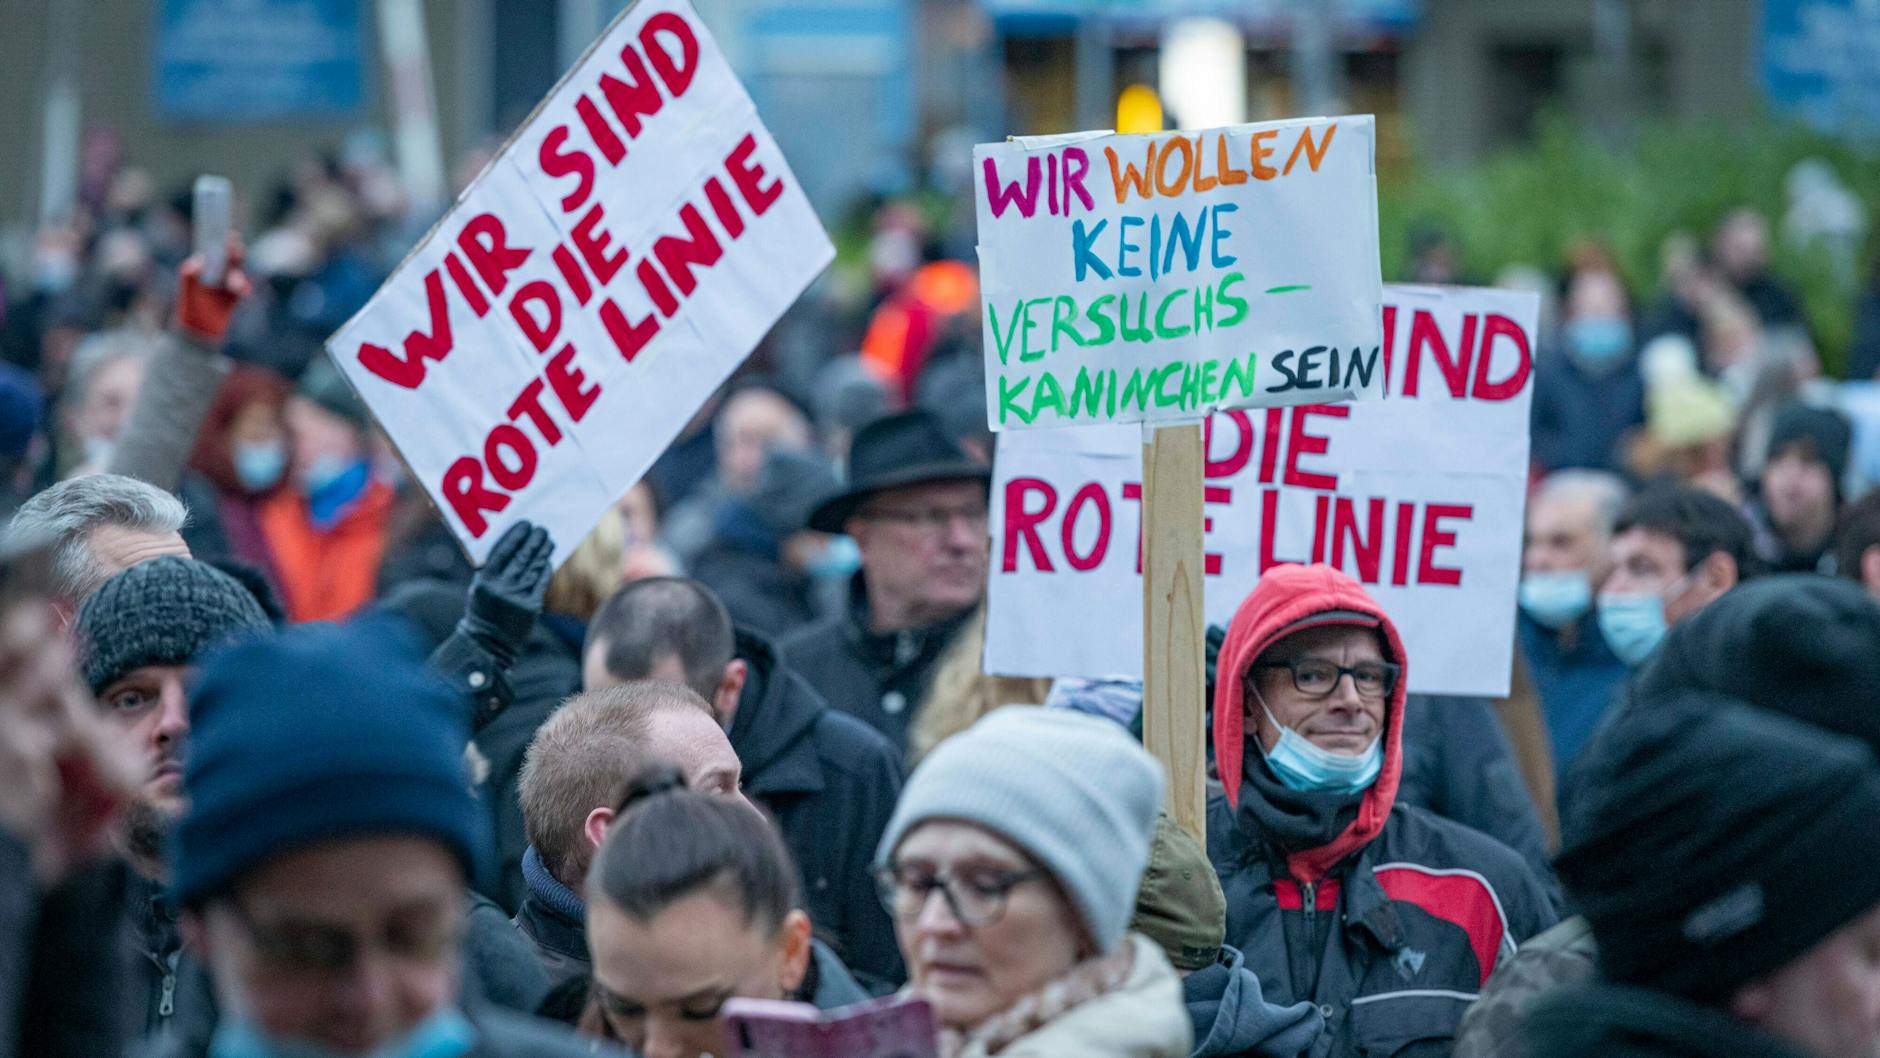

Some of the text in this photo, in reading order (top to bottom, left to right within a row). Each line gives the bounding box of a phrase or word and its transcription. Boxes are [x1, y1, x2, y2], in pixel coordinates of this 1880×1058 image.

[357, 10, 700, 389] WIR SIND
[982, 123, 1337, 219] WIR WOLLEN
[508, 202, 630, 353] DIE
[1071, 201, 1240, 283] KEINE
[441, 133, 784, 539] ROTE LINIE
[988, 271, 1250, 366] VERSUCHS
[998, 345, 1380, 425] KANINCHEN SEIN
[1204, 402, 1351, 491] DIE
[1259, 489, 1474, 586] LINIE
